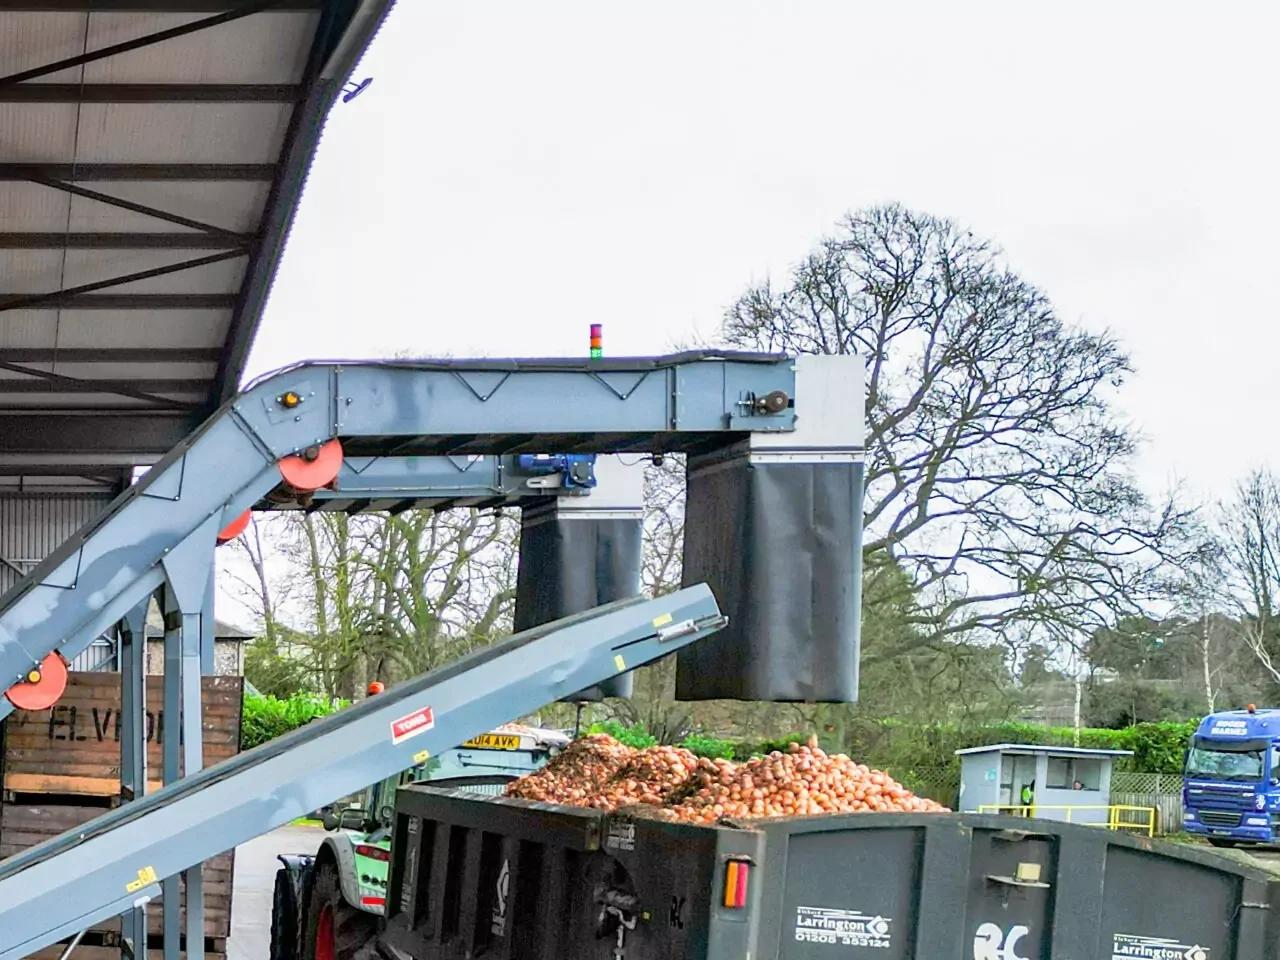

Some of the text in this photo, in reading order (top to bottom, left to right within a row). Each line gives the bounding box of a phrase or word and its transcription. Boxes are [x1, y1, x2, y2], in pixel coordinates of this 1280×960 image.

[494, 736, 516, 748] AVK
[797, 915, 864, 931] Larrington
[795, 933, 891, 948] 01205 353124
[1114, 942, 1182, 960] Larrington
